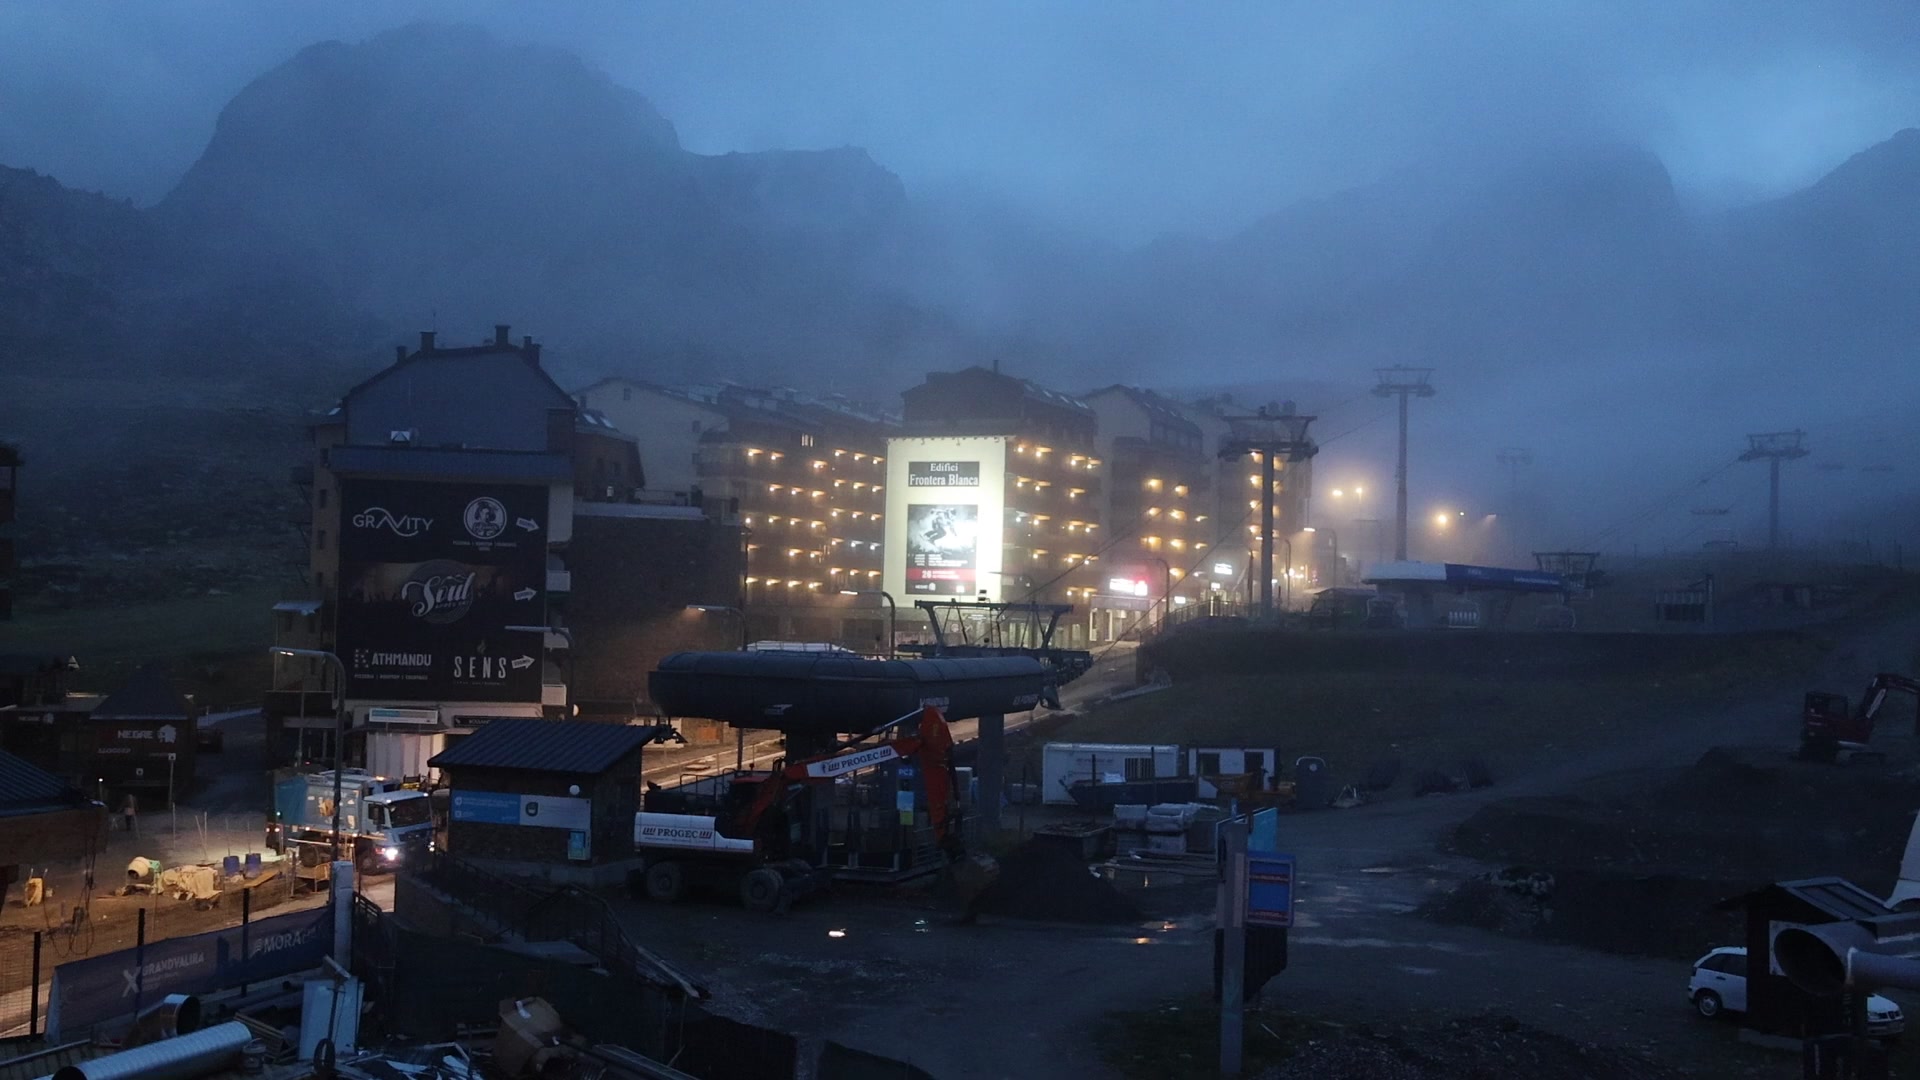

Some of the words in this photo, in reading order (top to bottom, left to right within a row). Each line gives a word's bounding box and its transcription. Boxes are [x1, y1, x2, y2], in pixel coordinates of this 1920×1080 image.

[930, 463, 958, 472] Edifici
[909, 473, 946, 486] Frontera
[948, 473, 979, 486] Blanca
[352, 507, 434, 537] GRAVITY
[401, 572, 477, 617] Soul
[453, 656, 507, 679] SENS
[841, 751, 879, 768] PROGEC
[898, 768, 913, 776] PC2
[657, 828, 698, 839] PROGEC
[142, 951, 205, 977] GRANDVALIRA
